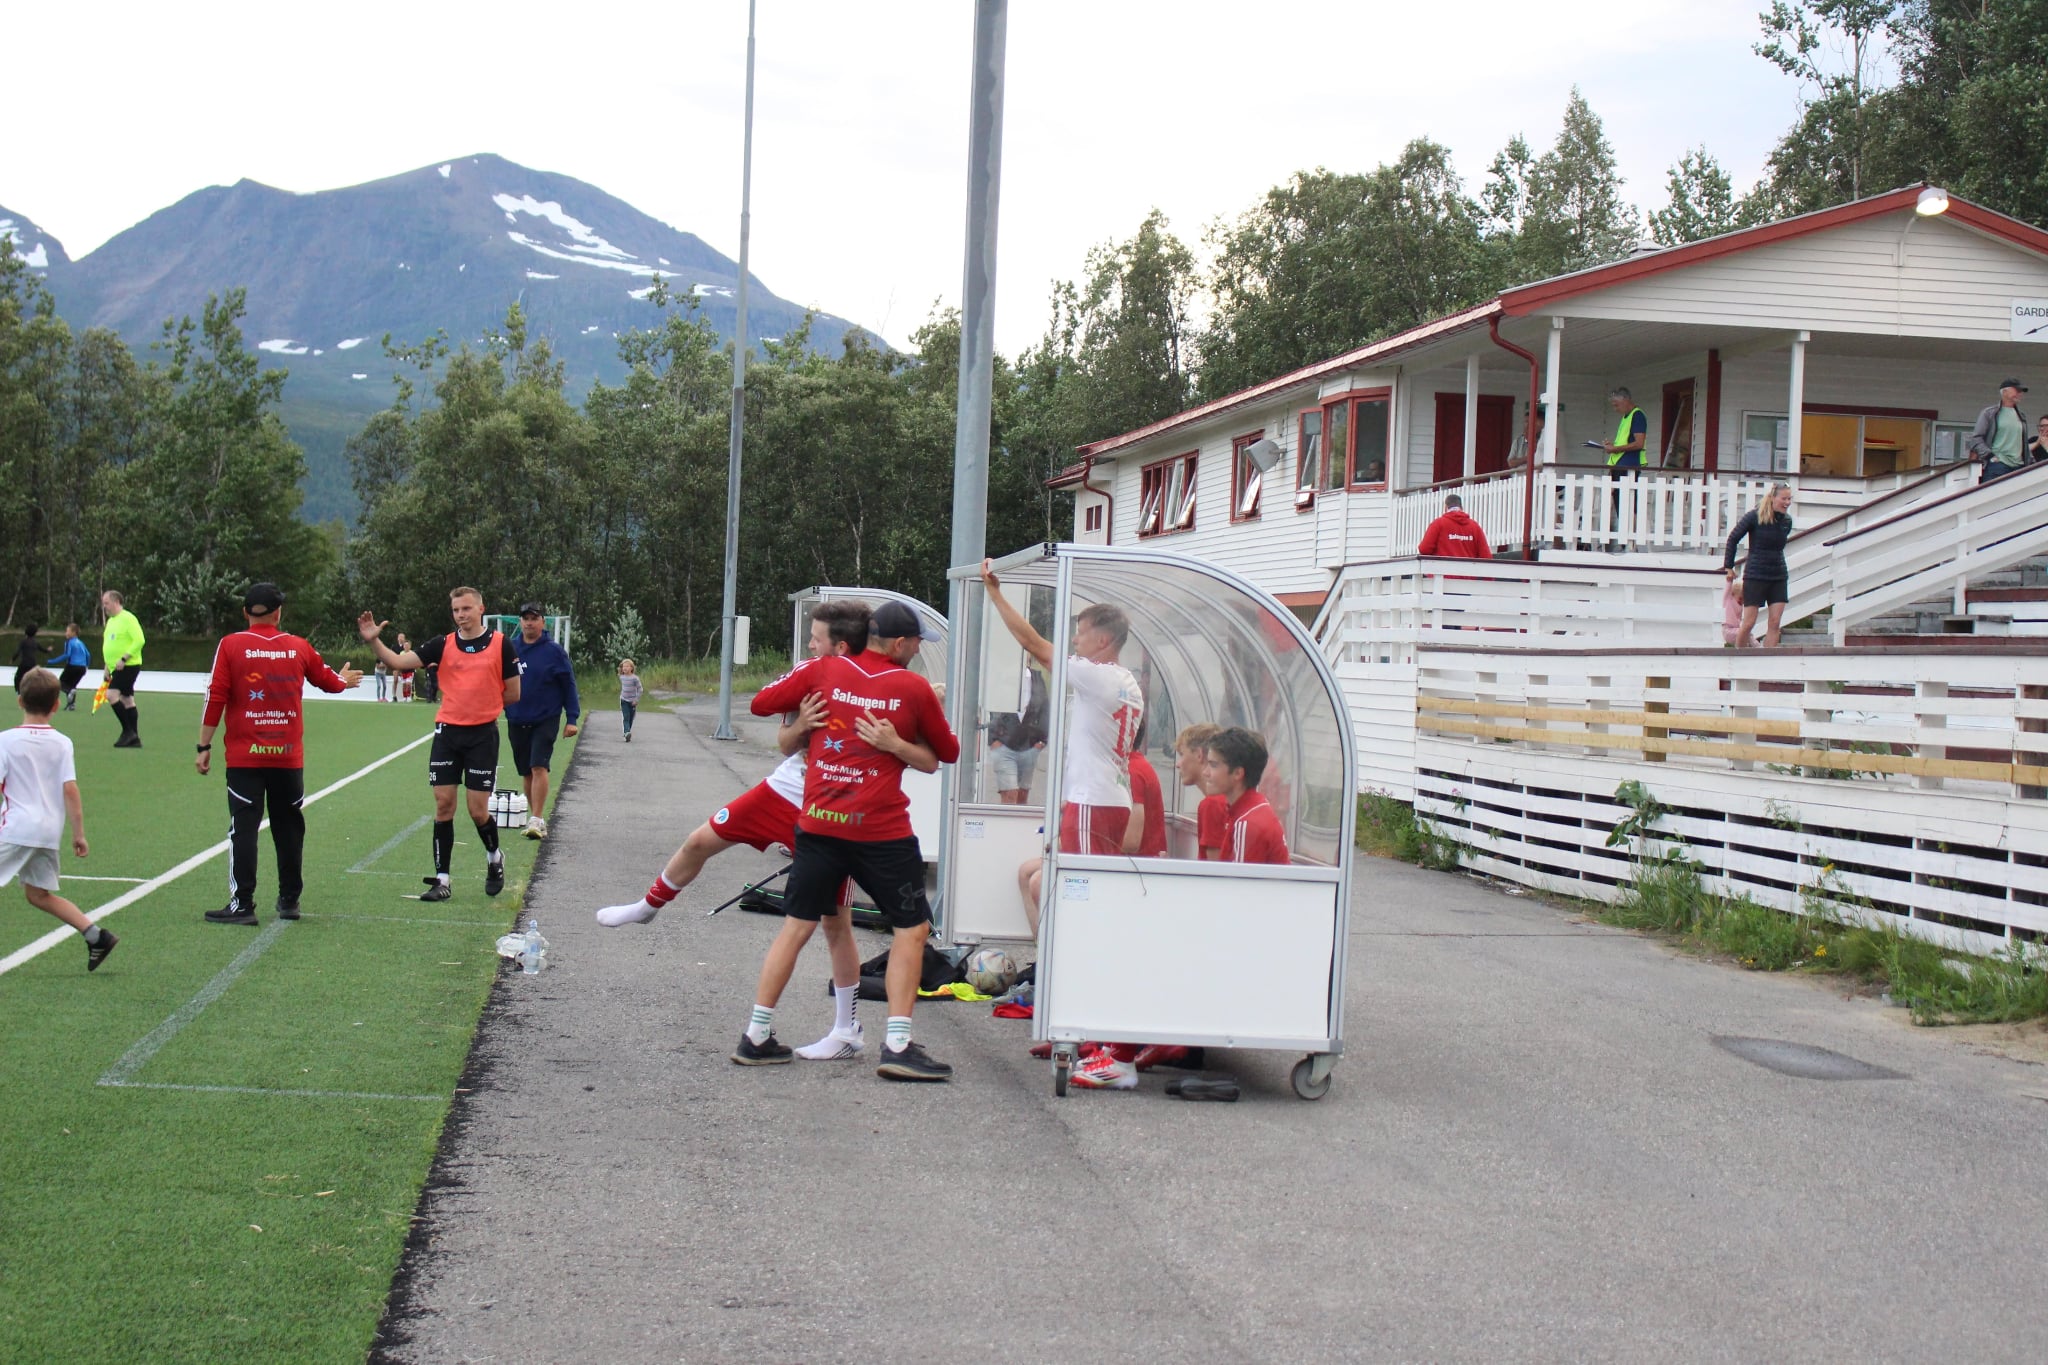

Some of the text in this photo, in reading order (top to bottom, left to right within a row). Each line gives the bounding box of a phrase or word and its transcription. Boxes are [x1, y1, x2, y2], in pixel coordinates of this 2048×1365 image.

[245, 649, 297, 659] Salangen IF
[832, 687, 901, 711] Salangen IF
